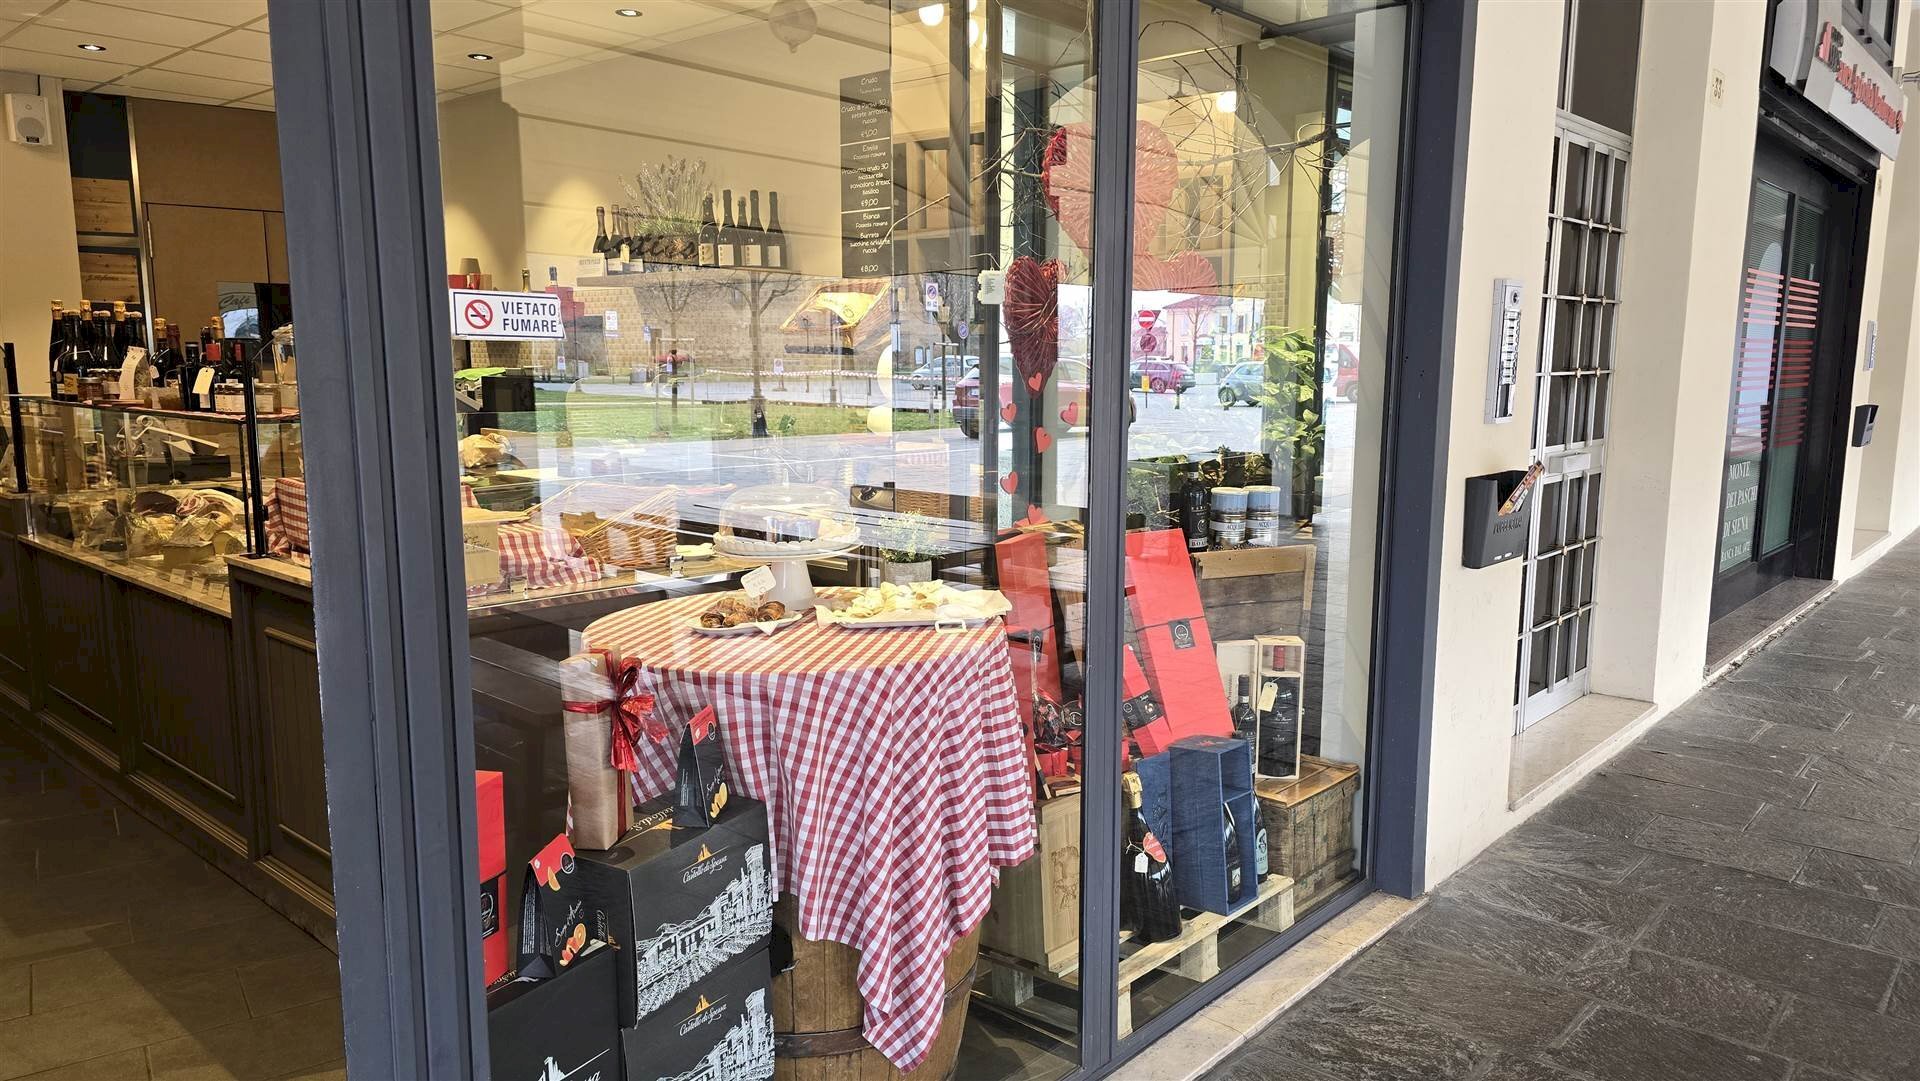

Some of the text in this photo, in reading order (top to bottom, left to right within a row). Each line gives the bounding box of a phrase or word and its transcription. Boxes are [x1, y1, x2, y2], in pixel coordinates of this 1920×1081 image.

[501, 301, 556, 317] VIETATO
[503, 318, 558, 333] FUMARE
[1729, 461, 1751, 480] MONTE
